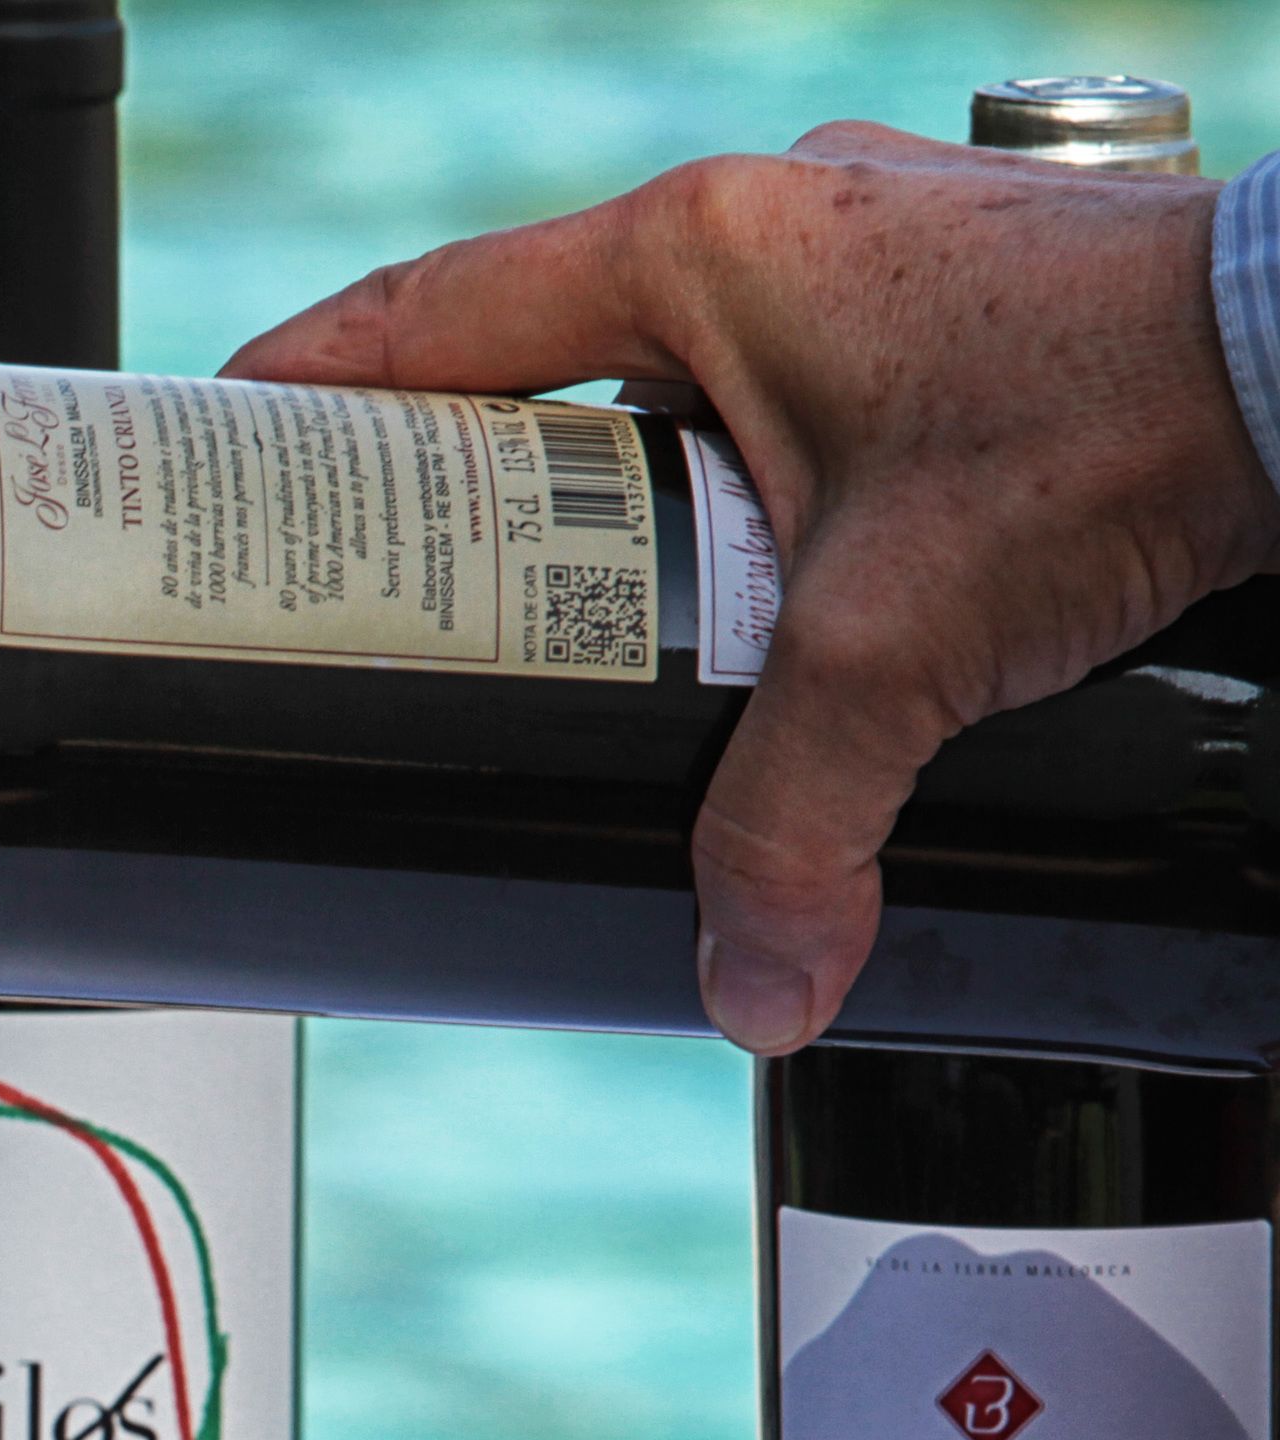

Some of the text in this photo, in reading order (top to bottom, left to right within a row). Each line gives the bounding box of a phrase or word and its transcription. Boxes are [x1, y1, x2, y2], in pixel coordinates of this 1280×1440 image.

[294, 439, 311, 456] the
[411, 431, 427, 446] por
[70, 426, 91, 508] BINISSALEM
[104, 385, 142, 531] TINTO CRIANZA
[271, 445, 290, 468] and
[297, 458, 314, 471] in
[343, 438, 369, 480] produce
[432, 453, 448, 473] PM
[157, 459, 177, 515] tradición
[228, 449, 254, 505] permiten
[320, 462, 339, 489] and
[347, 480, 364, 494] to
[414, 447, 434, 521] embotellado
[435, 475, 450, 498] 894
[447, 402, 482, 545] www.vinosferrer.com
[275, 470, 296, 528] tradition
[298, 474, 324, 538] vineyards
[351, 497, 365, 511] us
[377, 440, 405, 547] preferentemente
[437, 501, 451, 519] RE
[504, 494, 540, 516] cl.
[622, 463, 646, 524] 413765
[160, 519, 177, 536] de
[183, 512, 200, 527] la
[206, 503, 225, 559] barricas
[233, 506, 247, 529] nos
[324, 491, 345, 559] American
[424, 523, 436, 532] y
[507, 520, 542, 543] 75
[184, 529, 201, 547] de
[278, 527, 302, 547] of
[350, 514, 367, 560] allows
[632, 535, 648, 546] 8
[161, 540, 178, 573] años
[184, 551, 201, 586] viña
[230, 533, 256, 588] francés
[282, 550, 301, 587] years
[303, 540, 323, 585] prime
[161, 576, 178, 598] 80
[209, 562, 226, 604] 1000
[326, 560, 344, 602] 1000
[381, 549, 401, 599] Servir
[421, 535, 438, 612] Elaborado
[439, 533, 455, 631] BINISSALEM
[185, 592, 202, 609] de
[280, 590, 297, 612] 80
[301, 585, 326, 605] of
[523, 564, 538, 663] NOTA DE CATA
[890, 1259, 912, 1272] DE
[921, 1262, 942, 1274] LA
[953, 1263, 1014, 1277] TERRA
[1026, 1263, 1134, 1278] MALLORCA
